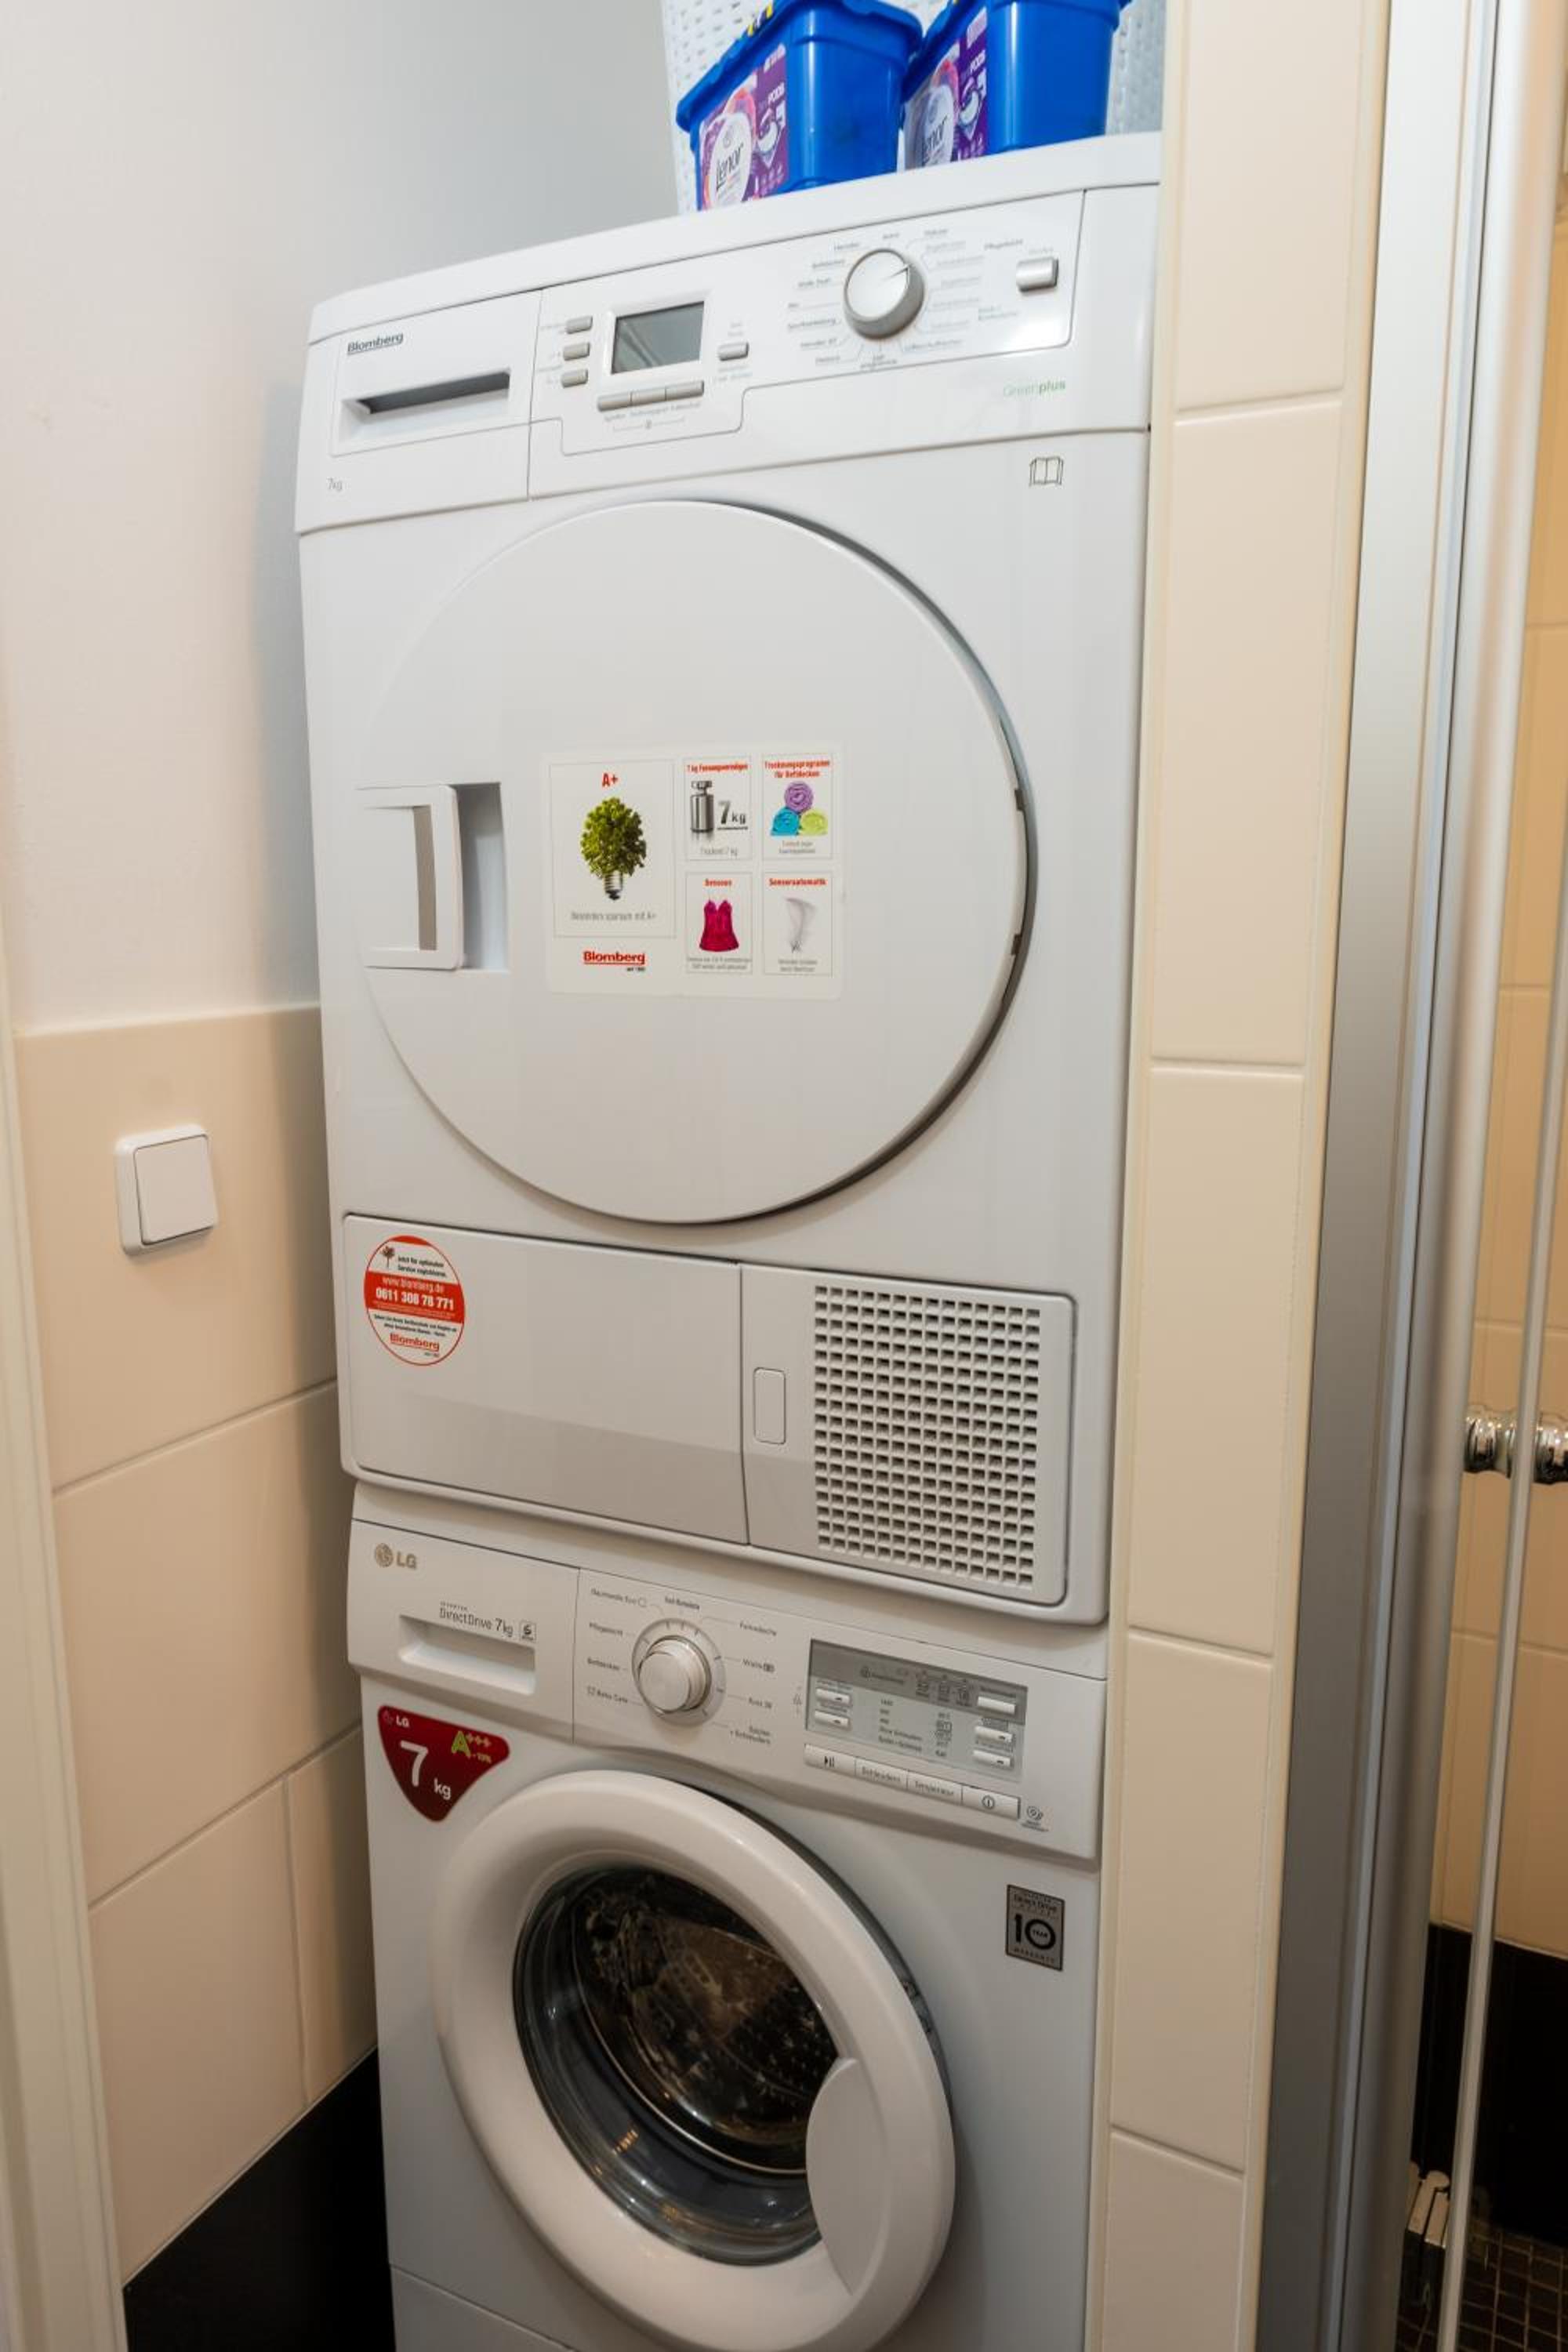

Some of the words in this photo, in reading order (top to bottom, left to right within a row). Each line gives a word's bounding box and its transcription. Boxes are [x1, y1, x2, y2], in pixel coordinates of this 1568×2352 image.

[716, 142, 744, 191] Lenor
[347, 332, 404, 355] Blomberg
[601, 772, 619, 788] A+
[718, 800, 730, 824] 7
[732, 811, 746, 824] kg
[583, 950, 645, 965] Blomberg
[390, 1332, 440, 1352] Blomberg
[397, 1551, 417, 1570] LG
[396, 1715, 410, 1727] LG
[400, 1739, 429, 1788] 7
[433, 1777, 452, 1801] kg
[1015, 1914, 1056, 1950] 10
